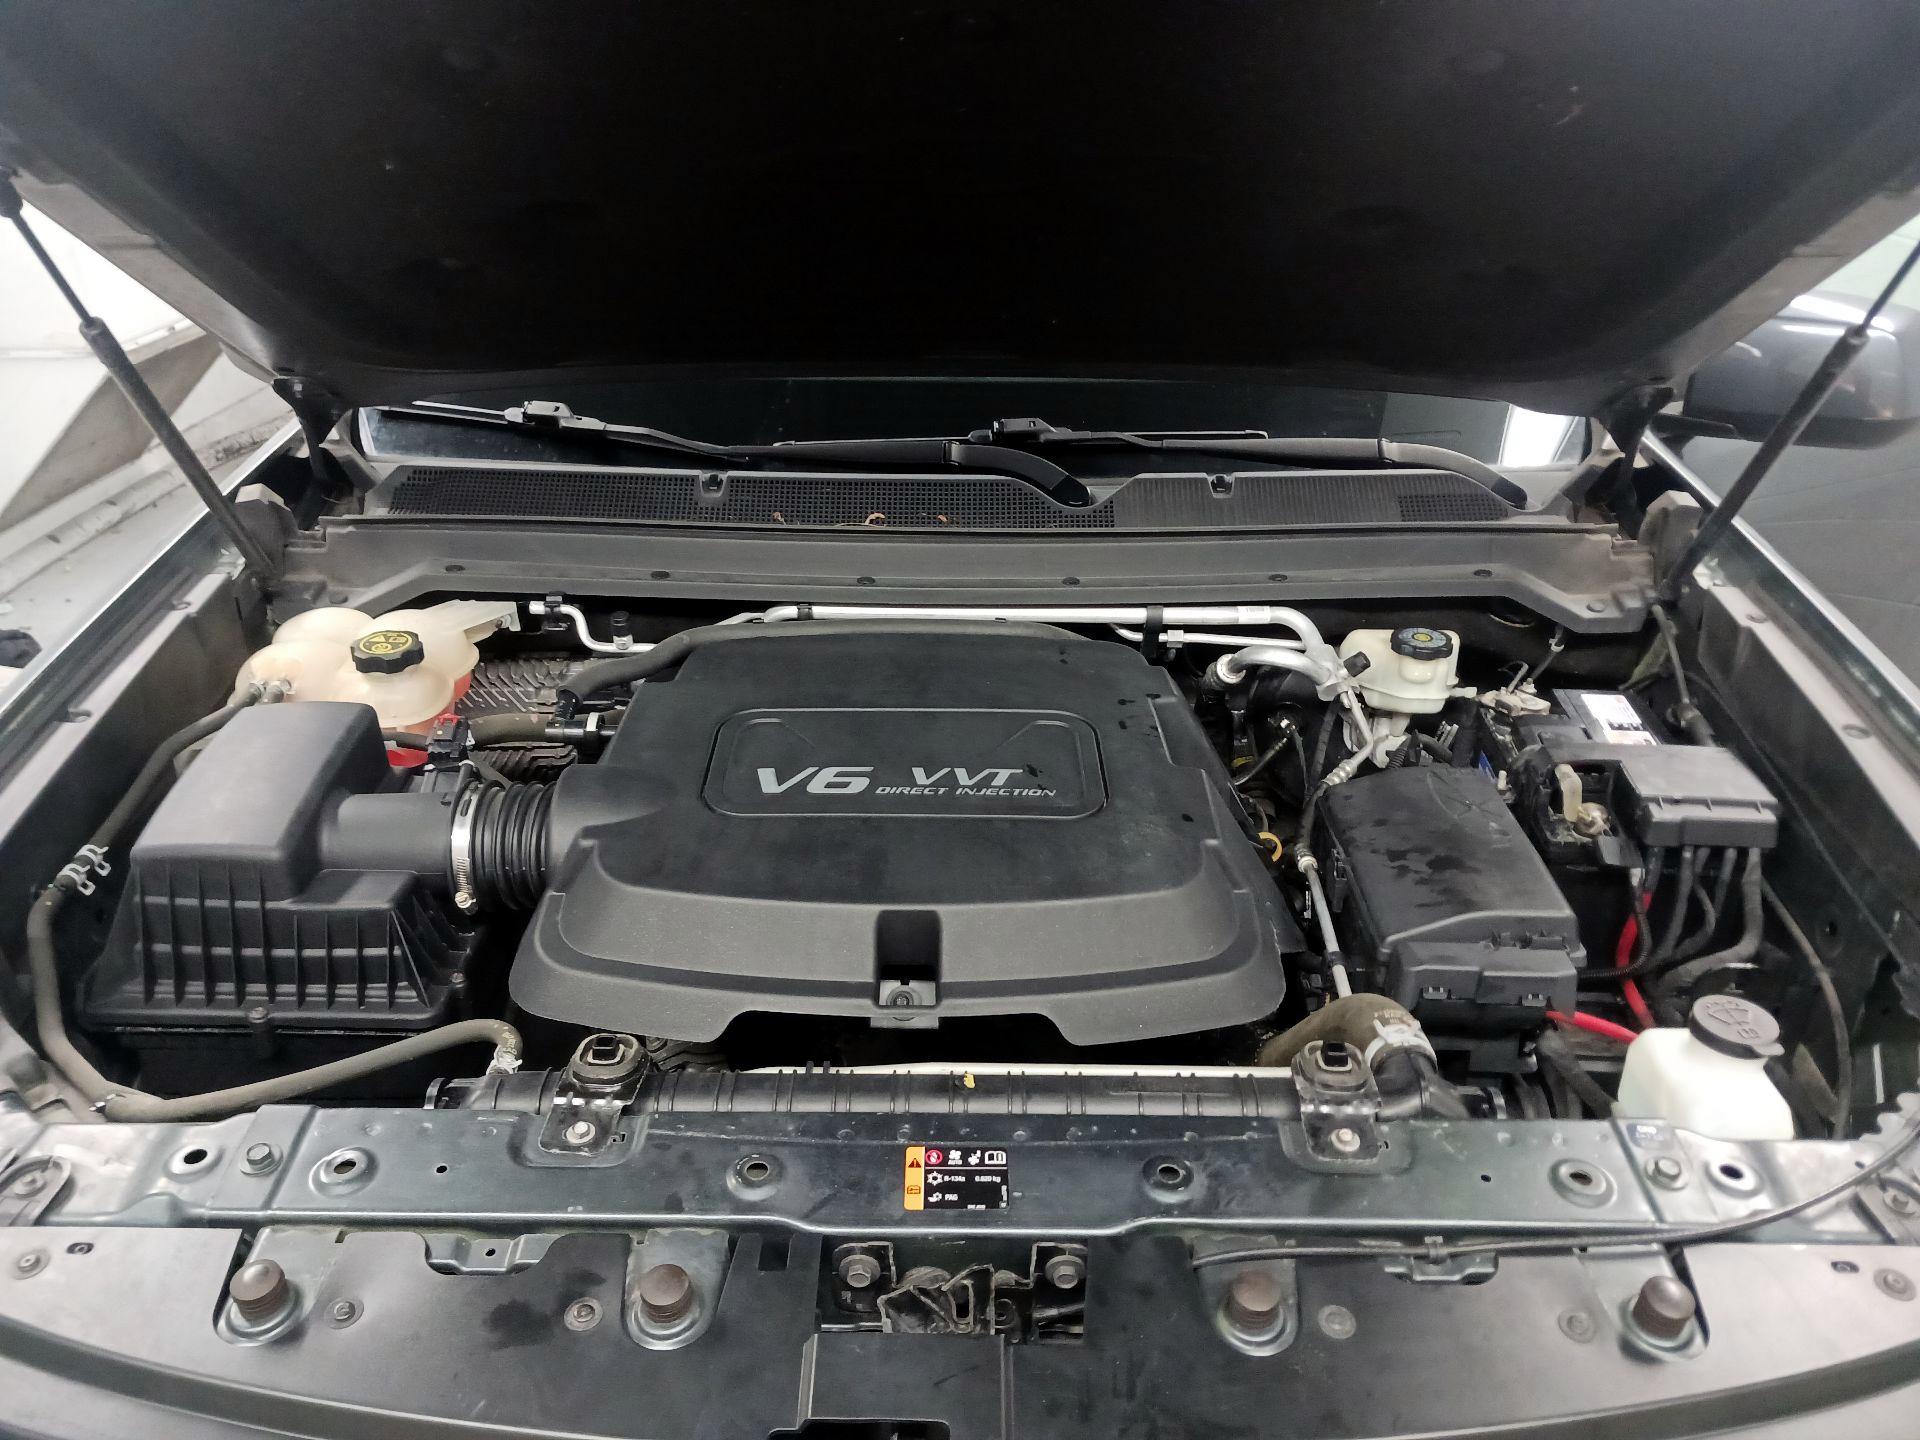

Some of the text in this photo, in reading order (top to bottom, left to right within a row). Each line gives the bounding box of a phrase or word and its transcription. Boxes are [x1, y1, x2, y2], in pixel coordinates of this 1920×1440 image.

[757, 767, 1024, 794] V6 VVT
[875, 787, 1057, 797] DIRECT INJECTION
[944, 1193, 958, 1201] PAG
